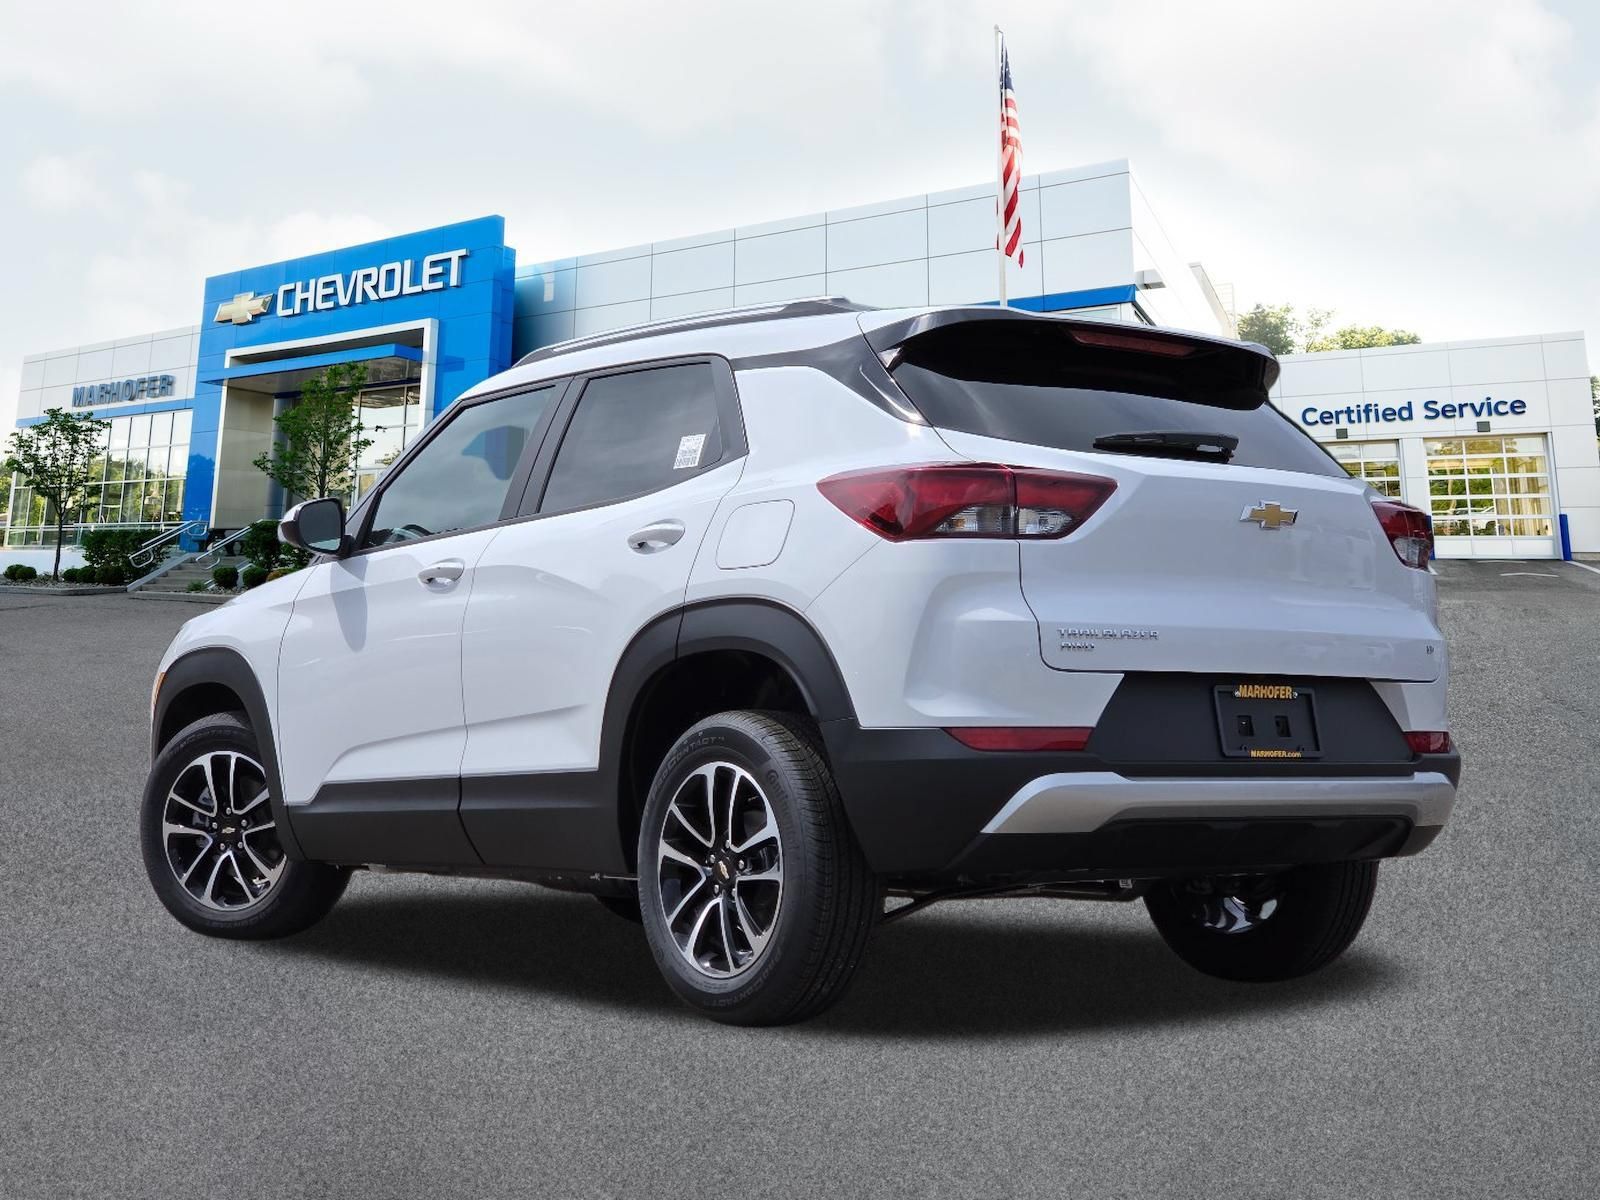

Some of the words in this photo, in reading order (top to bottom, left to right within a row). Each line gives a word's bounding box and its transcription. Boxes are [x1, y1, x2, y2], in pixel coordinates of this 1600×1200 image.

[276, 248, 469, 318] CHEVROLET
[72, 374, 175, 408] MARHOFER
[1301, 401, 1414, 427] Certified
[1423, 396, 1528, 421] Service
[1058, 627, 1159, 640] TRAILBLAZER
[1239, 684, 1293, 699] MARHOFER
[1250, 749, 1302, 759] MARHOFER.com
